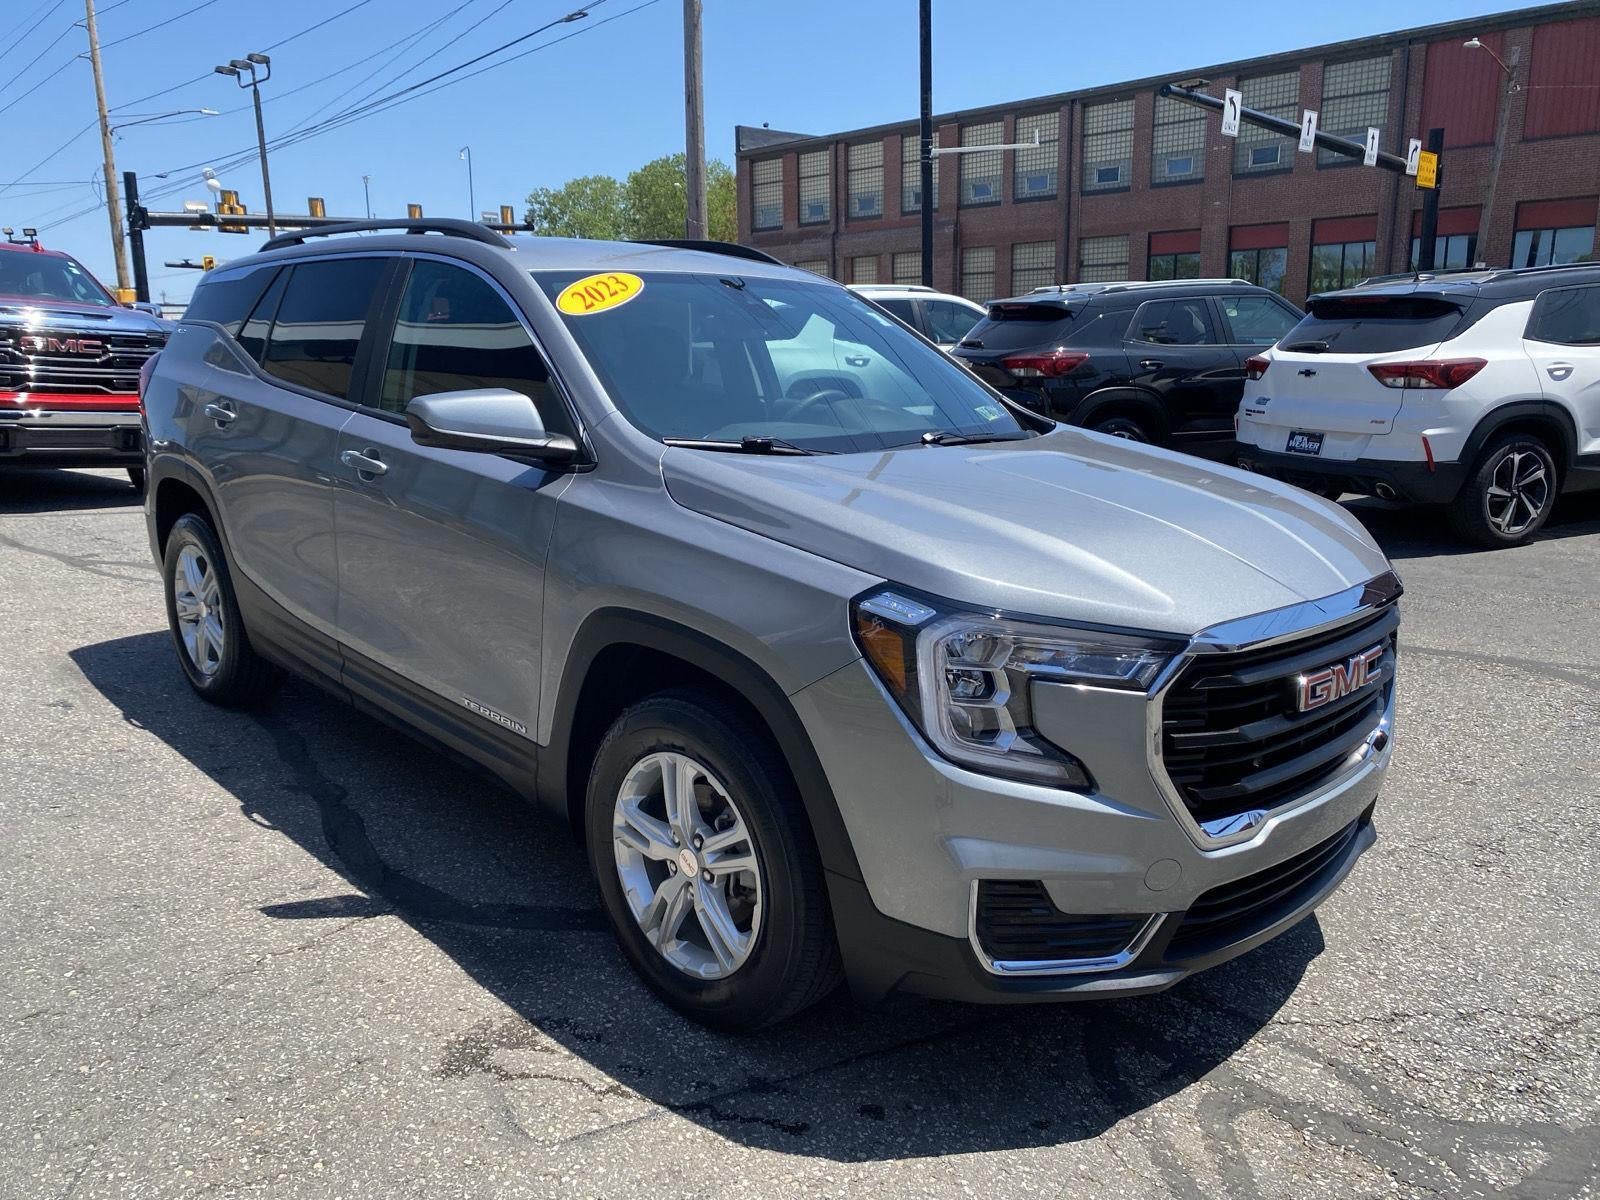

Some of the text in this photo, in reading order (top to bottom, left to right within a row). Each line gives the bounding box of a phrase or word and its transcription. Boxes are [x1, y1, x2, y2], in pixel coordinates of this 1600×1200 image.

[1224, 121, 1236, 132] ONLY
[571, 276, 628, 310] 2023
[20, 335, 102, 354] GMC
[1289, 440, 1320, 451] WEAVER
[1297, 645, 1382, 712] GMC
[460, 697, 527, 734] TERRAIN
